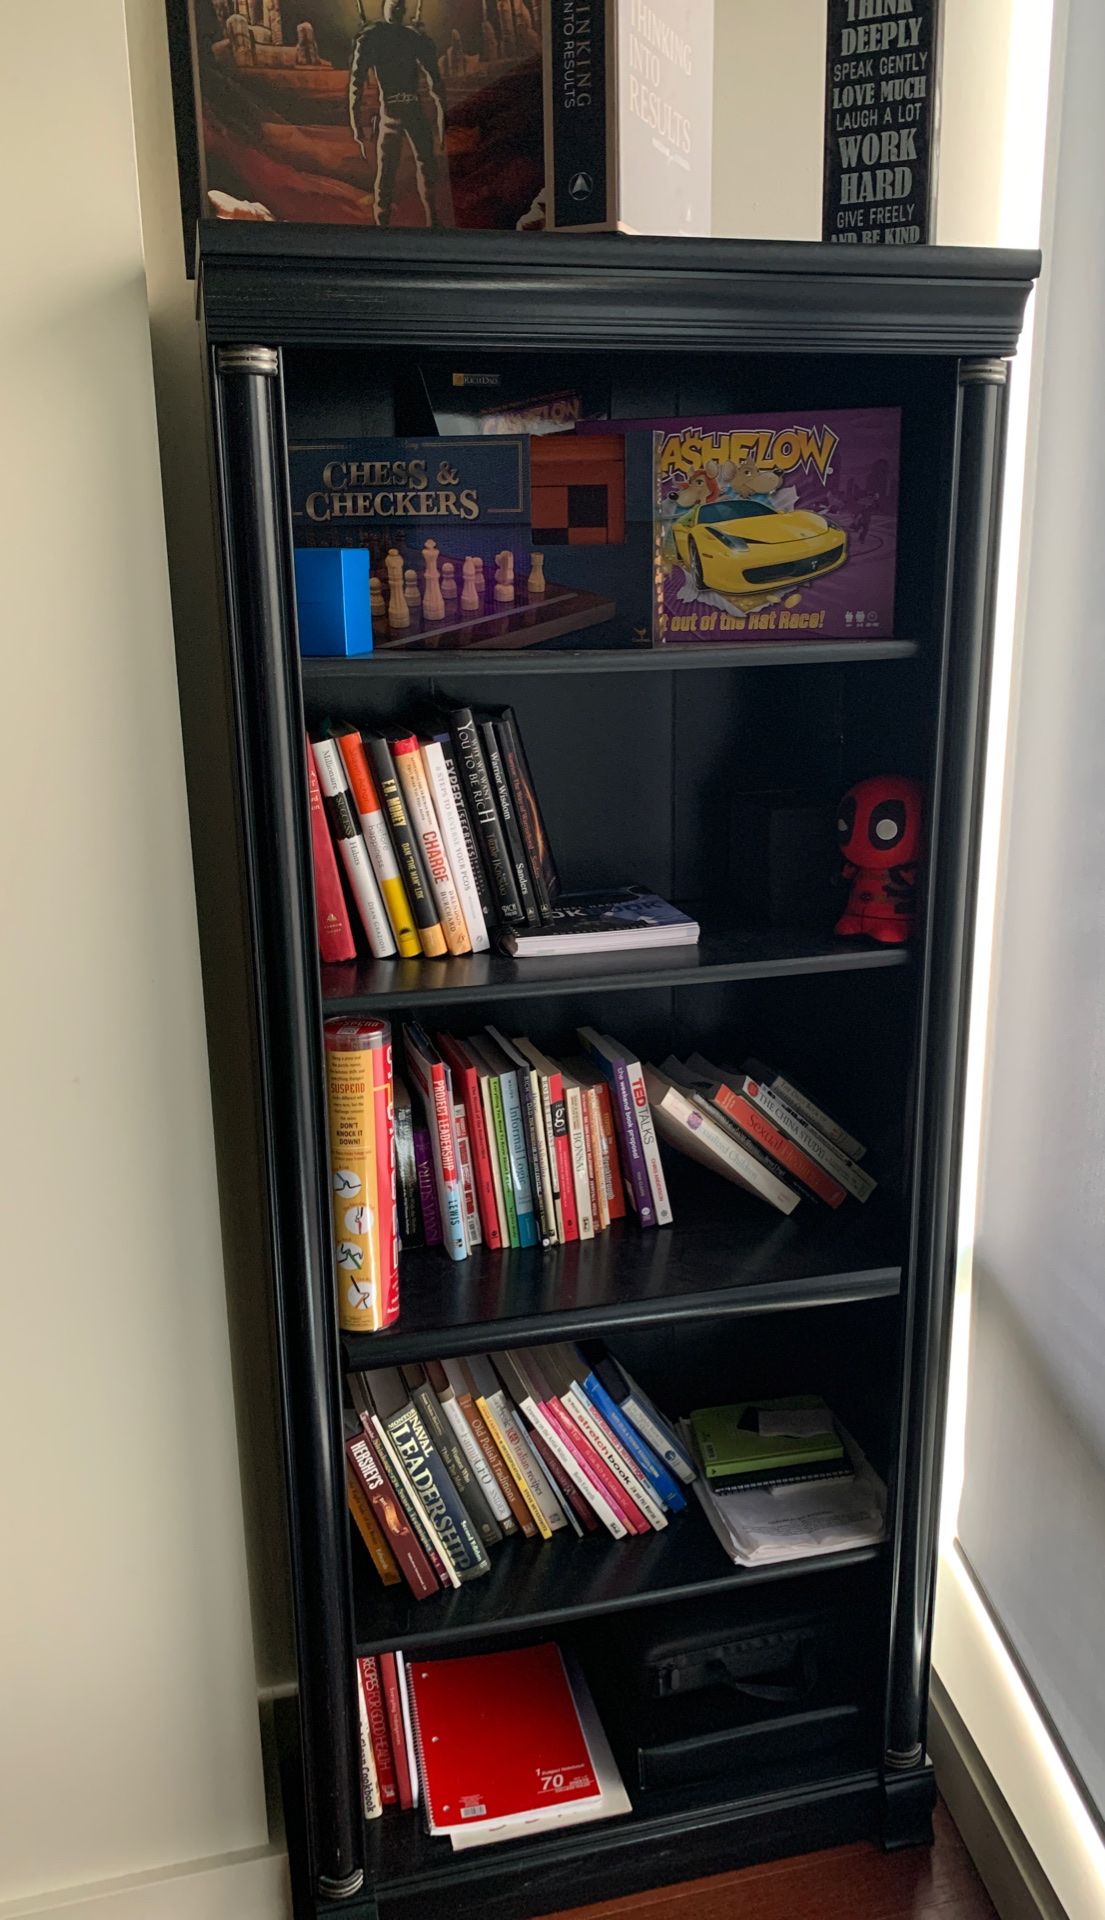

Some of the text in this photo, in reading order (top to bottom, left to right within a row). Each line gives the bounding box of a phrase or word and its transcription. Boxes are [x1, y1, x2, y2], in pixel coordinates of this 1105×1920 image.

[562, 0, 576, 109] NTO RESULTS
[575, 0, 592, 107] INKING
[631, 0, 693, 76] THINKING
[840, 17, 923, 57] DEEPLY
[629, 32, 661, 87] INTO
[833, 51, 928, 82] SPEAK GENTLY
[832, 75, 927, 109] LOVE MUCH
[630, 73, 692, 154] RESULTS
[836, 102, 922, 130] LAUGH A LOT
[838, 127, 918, 169] WORK
[840, 166, 913, 205] HARD
[836, 203, 916, 228] GIVE FREELY
[884, 225, 921, 245] KIND
[322, 459, 460, 491] CHESS &
[660, 425, 839, 486] ASHFLOW
[305, 489, 480, 523] CHECKERS
[670, 615, 698, 632] out
[701, 611, 718, 632] of
[778, 610, 825, 629] Race!
[321, 749, 339, 790] Millionaire
[454, 720, 495, 824] YOU TO BE RICH
[469, 737, 491, 801] WHY WE WANT
[489, 751, 513, 820] Warrior Wisdom
[335, 795, 353, 836] SUCCESS
[381, 778, 406, 828] F.U. MONEY
[444, 758, 476, 857] EXPERT SECRETS
[348, 841, 361, 866] Habits
[366, 823, 385, 869] happiness
[375, 821, 389, 851] before
[400, 841, 411, 856] DAN
[413, 886, 424, 900] LOK
[421, 830, 448, 885] CHARGE
[454, 847, 466, 870] YOUR
[459, 869, 471, 891] PCOS
[514, 862, 530, 895] Sanders
[367, 901, 377, 919] DEAN
[439, 890, 456, 933] BURCHARD
[330, 1082, 366, 1095] SUSPEND
[615, 1066, 625, 1080] the
[616, 1080, 631, 1111] weekend
[630, 1077, 657, 1145] TED TALKS
[336, 1129, 356, 1138] KNOCK
[339, 1122, 359, 1130] DON'T
[432, 1079, 454, 1171] PROJECT LEADERSHIP
[623, 1111, 634, 1127] book
[744, 1113, 783, 1150] Sexual
[757, 1094, 777, 1113] THE
[772, 1108, 800, 1134] CHINA
[797, 1131, 826, 1159] STUDY
[339, 1138, 361, 1146] DOWN!
[507, 1105, 530, 1185] Informal Logic
[624, 1128, 641, 1160] proposal
[417, 1160, 436, 1203] SUTRA
[600, 1155, 615, 1200] Breakthrough
[649, 1157, 665, 1202] CHRIS ANDERSON
[447, 1199, 460, 1225] LEWIS
[537, 1422, 545, 1431] on
[542, 1428, 551, 1438] the
[547, 1435, 560, 1449] Artist
[576, 1412, 611, 1457] stretch
[606, 1452, 632, 1486] book
[349, 1439, 384, 1491] HERSHEY'S
[439, 1447, 452, 1465] Think
[452, 1474, 465, 1492] Much
[449, 1445, 472, 1483] Women Who
[470, 1417, 517, 1504] Old Polish Traditions
[473, 1457, 494, 1485] CFO
[513, 1444, 544, 1498] italian recipes
[389, 1422, 472, 1574] LEADERSHIP
[407, 1414, 483, 1562] NAVAL Second Edition
[522, 1488, 533, 1504] STEVE
[362, 1655, 391, 1771] RECIPES FOR GOOD HEALTH
[360, 1766, 375, 1813] Cookbook
[536, 1767, 541, 1777] 1
[541, 1774, 564, 1791] 70
